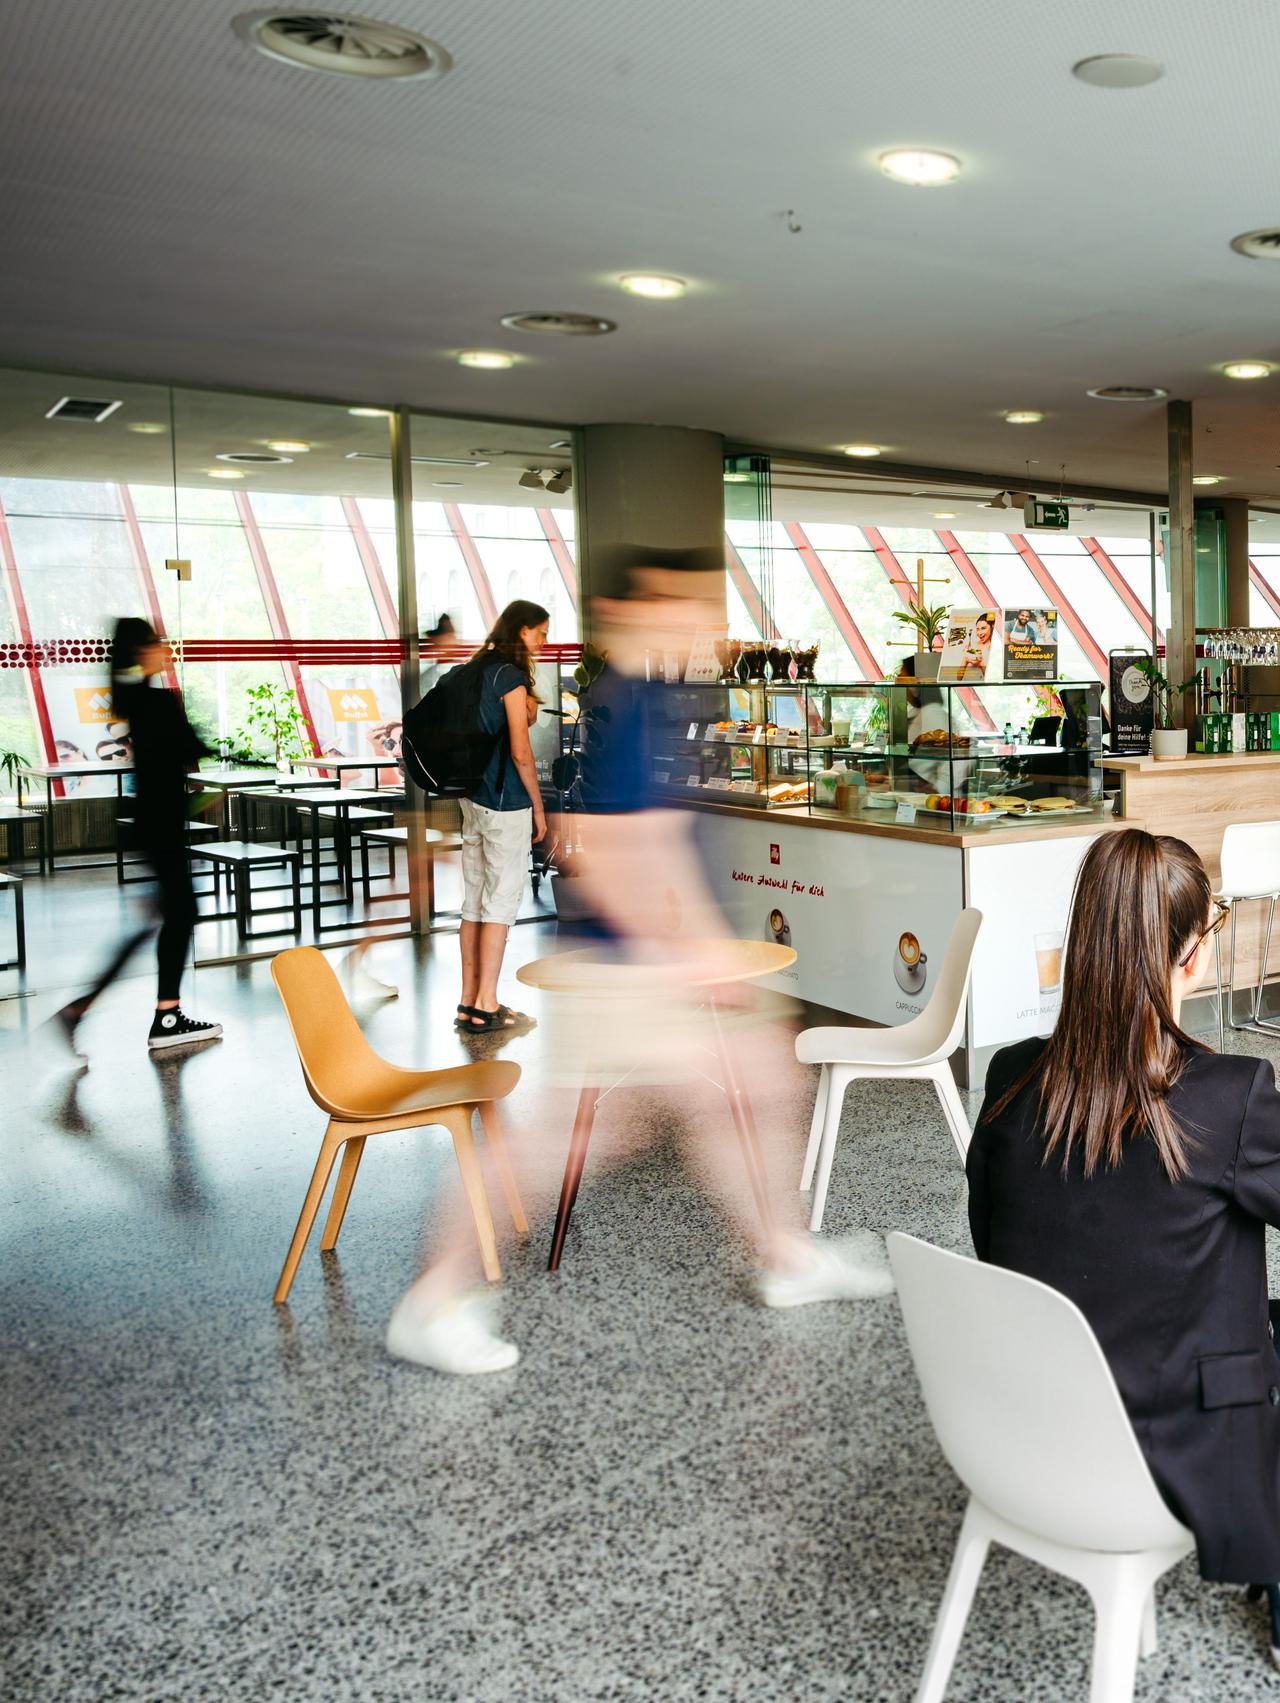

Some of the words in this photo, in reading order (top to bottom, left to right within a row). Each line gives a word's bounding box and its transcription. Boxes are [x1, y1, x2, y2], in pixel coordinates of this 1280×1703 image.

[1008, 644, 1030, 653] Ready
[732, 870, 754, 883] Unsere
[791, 880, 805, 894] für
[809, 885, 824, 897] dich
[896, 1001, 923, 1014] CAPPUCCI
[1017, 1009, 1038, 1019] LATTE
